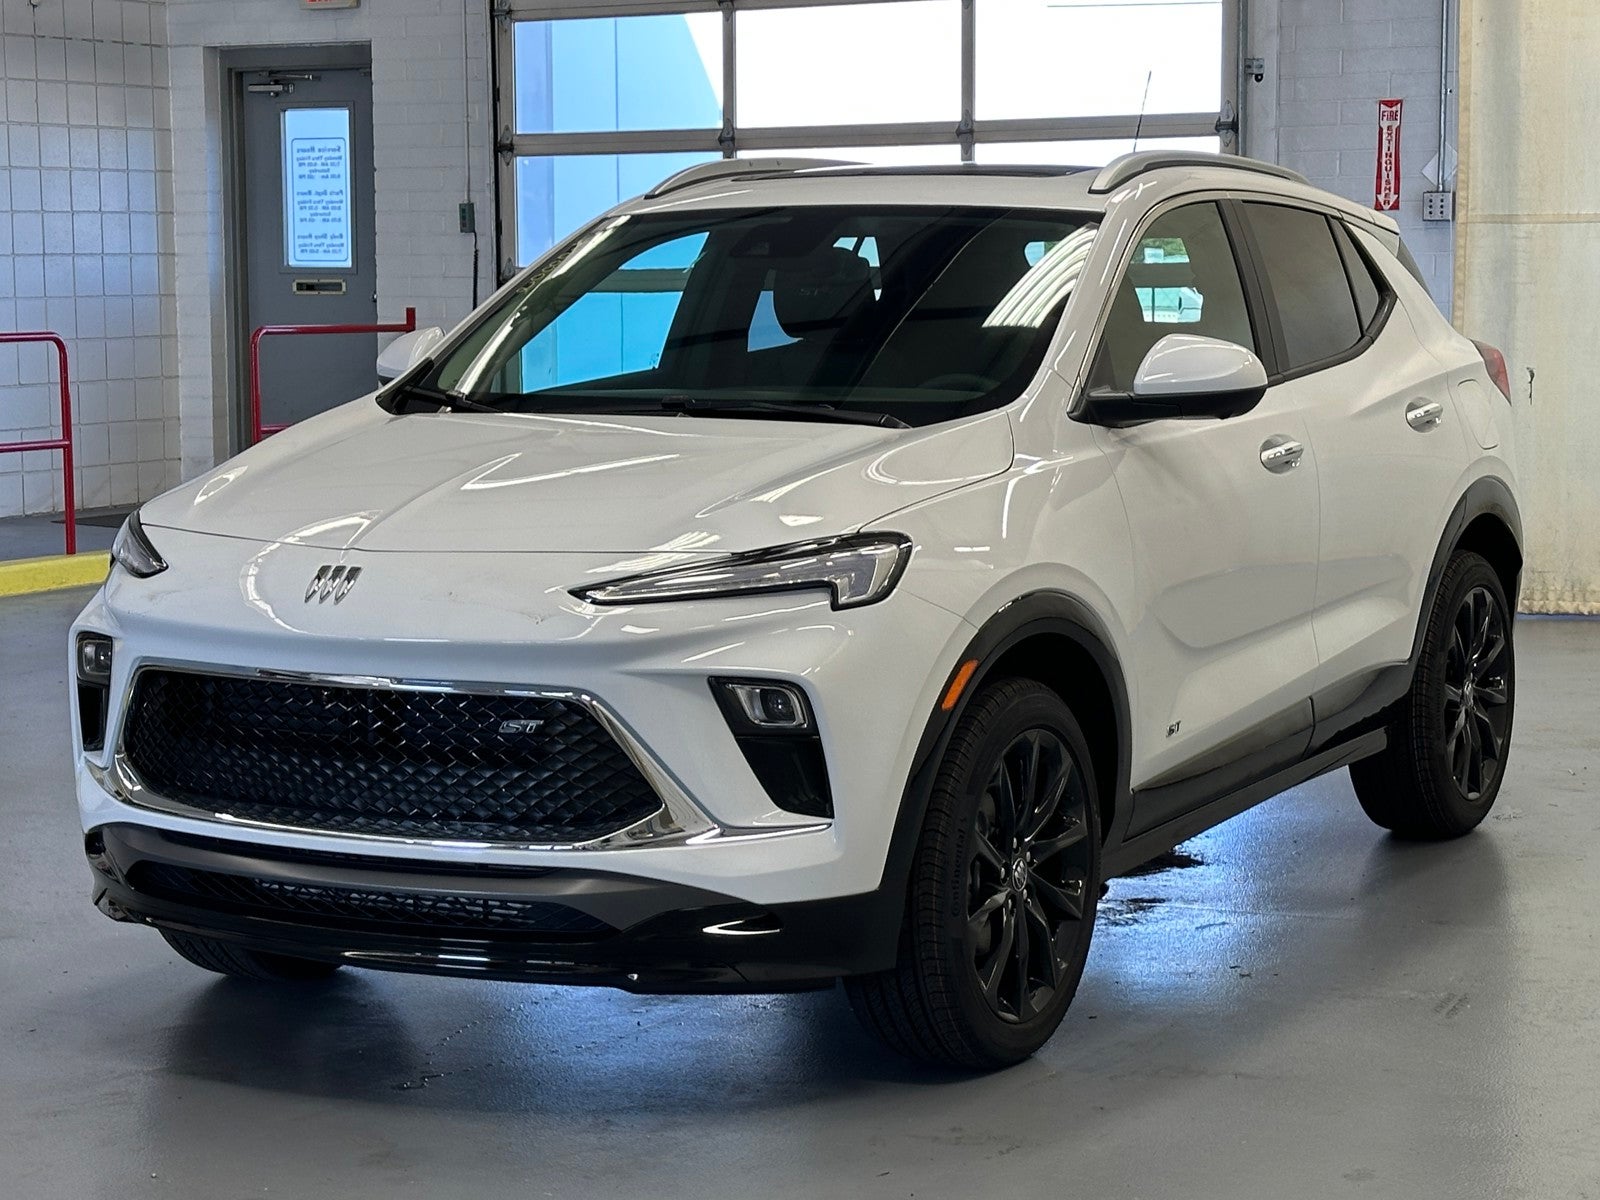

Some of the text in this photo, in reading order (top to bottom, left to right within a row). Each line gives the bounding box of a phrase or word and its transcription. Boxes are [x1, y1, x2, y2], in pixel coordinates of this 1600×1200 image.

[1381, 110, 1399, 121] FIRE
[1383, 125, 1393, 206] EXTINGUISHER
[499, 719, 544, 734] ST
[1166, 720, 1181, 738] ST
